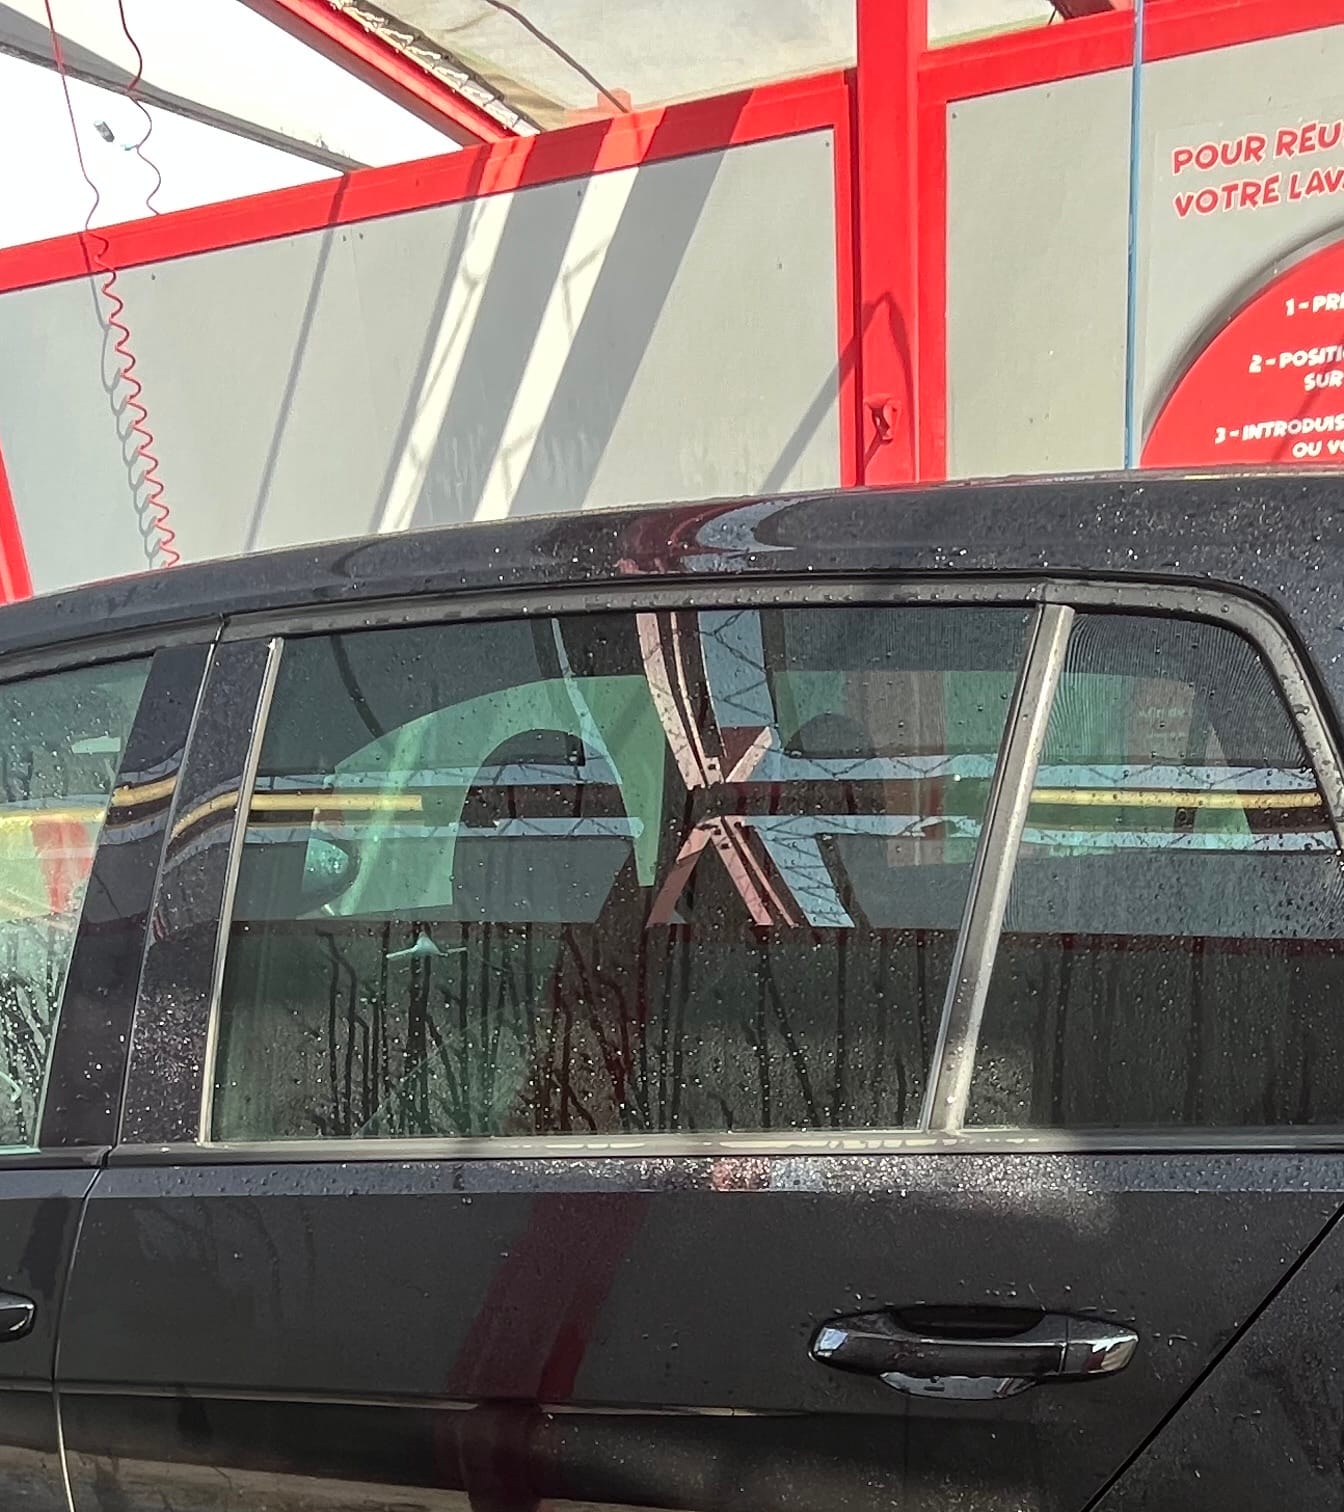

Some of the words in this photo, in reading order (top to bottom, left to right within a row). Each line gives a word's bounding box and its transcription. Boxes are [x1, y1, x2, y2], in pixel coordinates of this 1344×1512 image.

[1172, 135, 1267, 175] POUR
[1173, 172, 1282, 219] VOTRE
[1285, 299, 1295, 316] 1
[1249, 354, 1262, 373] 2
[1304, 370, 1344, 391] SUR
[1215, 427, 1226, 444] 3
[1292, 440, 1322, 458] OU
